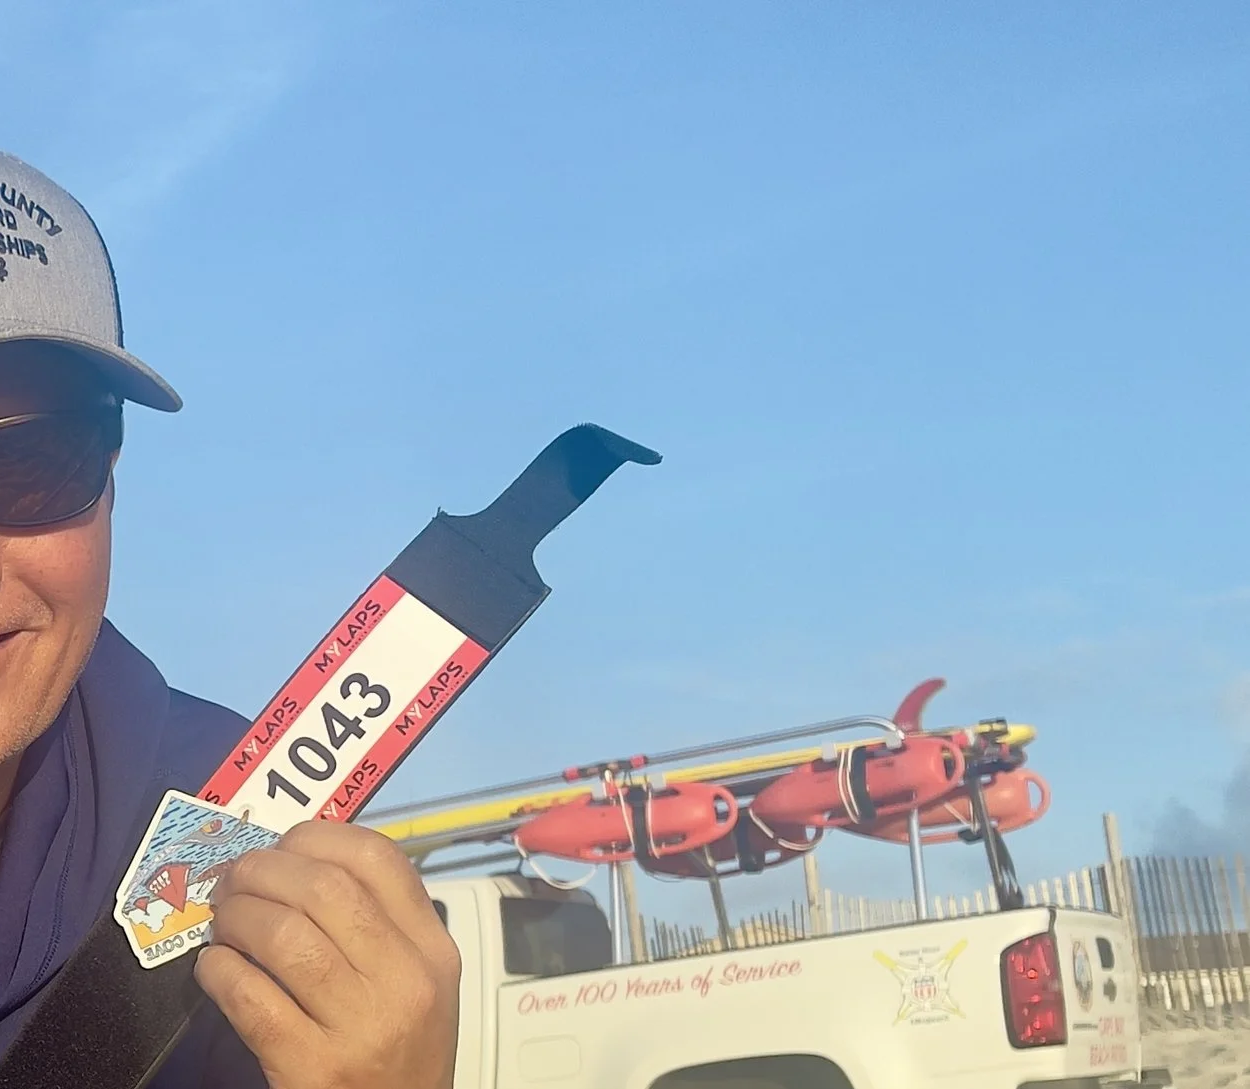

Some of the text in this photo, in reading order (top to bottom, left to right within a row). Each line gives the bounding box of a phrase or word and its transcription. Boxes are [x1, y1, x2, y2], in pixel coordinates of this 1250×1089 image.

[314, 599, 382, 673] MYLAPS
[234, 696, 298, 772] MYLAPS
[395, 660, 464, 736] MYLAPS
[266, 672, 391, 807] 1043
[143, 935, 185, 961] COVE
[517, 957, 803, 1016] Over 100 Years of Service
